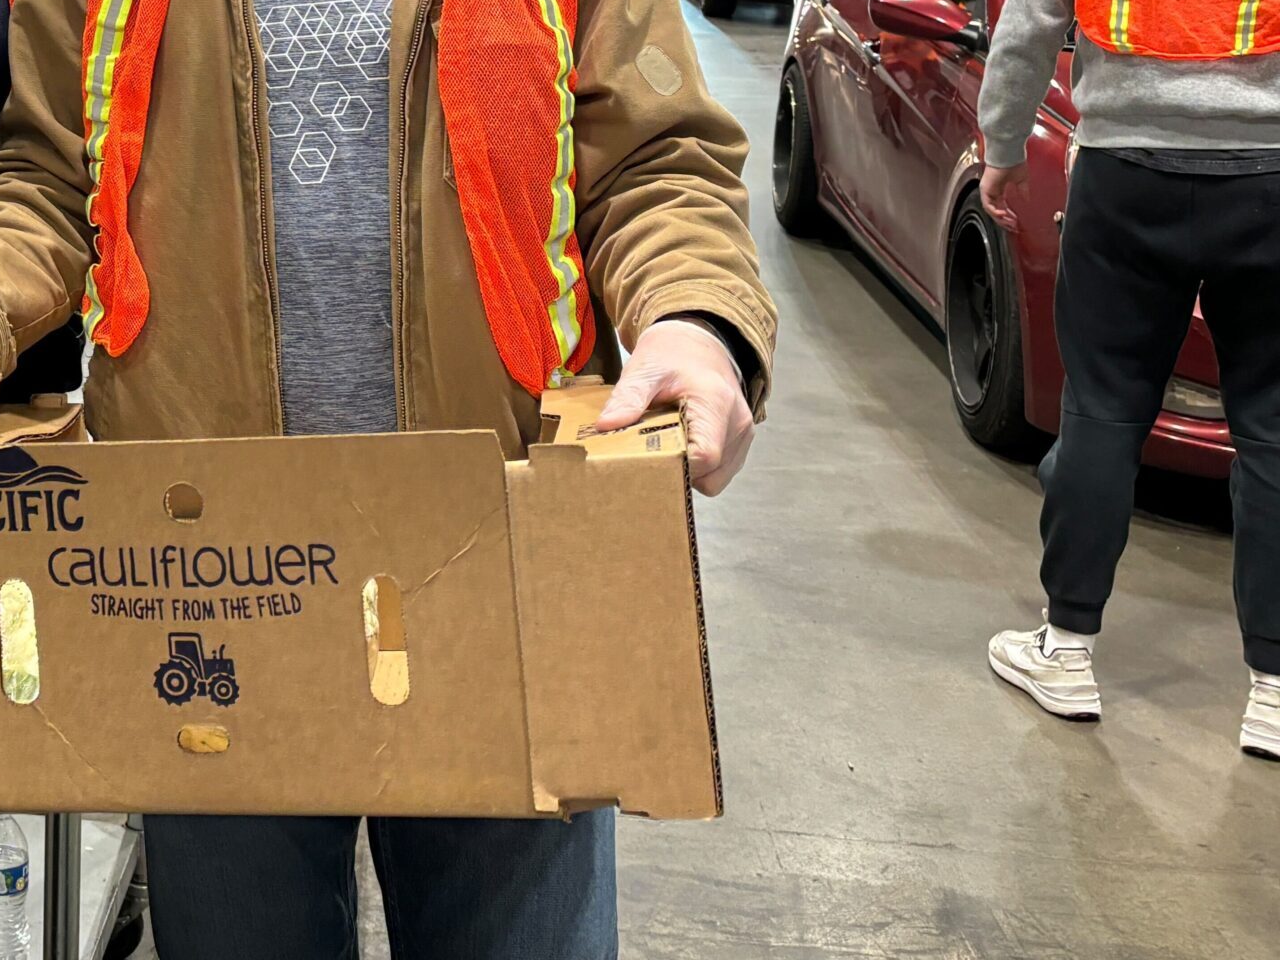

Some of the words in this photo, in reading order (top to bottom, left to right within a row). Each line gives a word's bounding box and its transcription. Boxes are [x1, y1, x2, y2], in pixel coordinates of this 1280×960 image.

[91, 593, 164, 620] STRAIGHT
[172, 599, 215, 621] FROM
[220, 596, 252, 620] THE
[257, 592, 301, 617] FIELD
